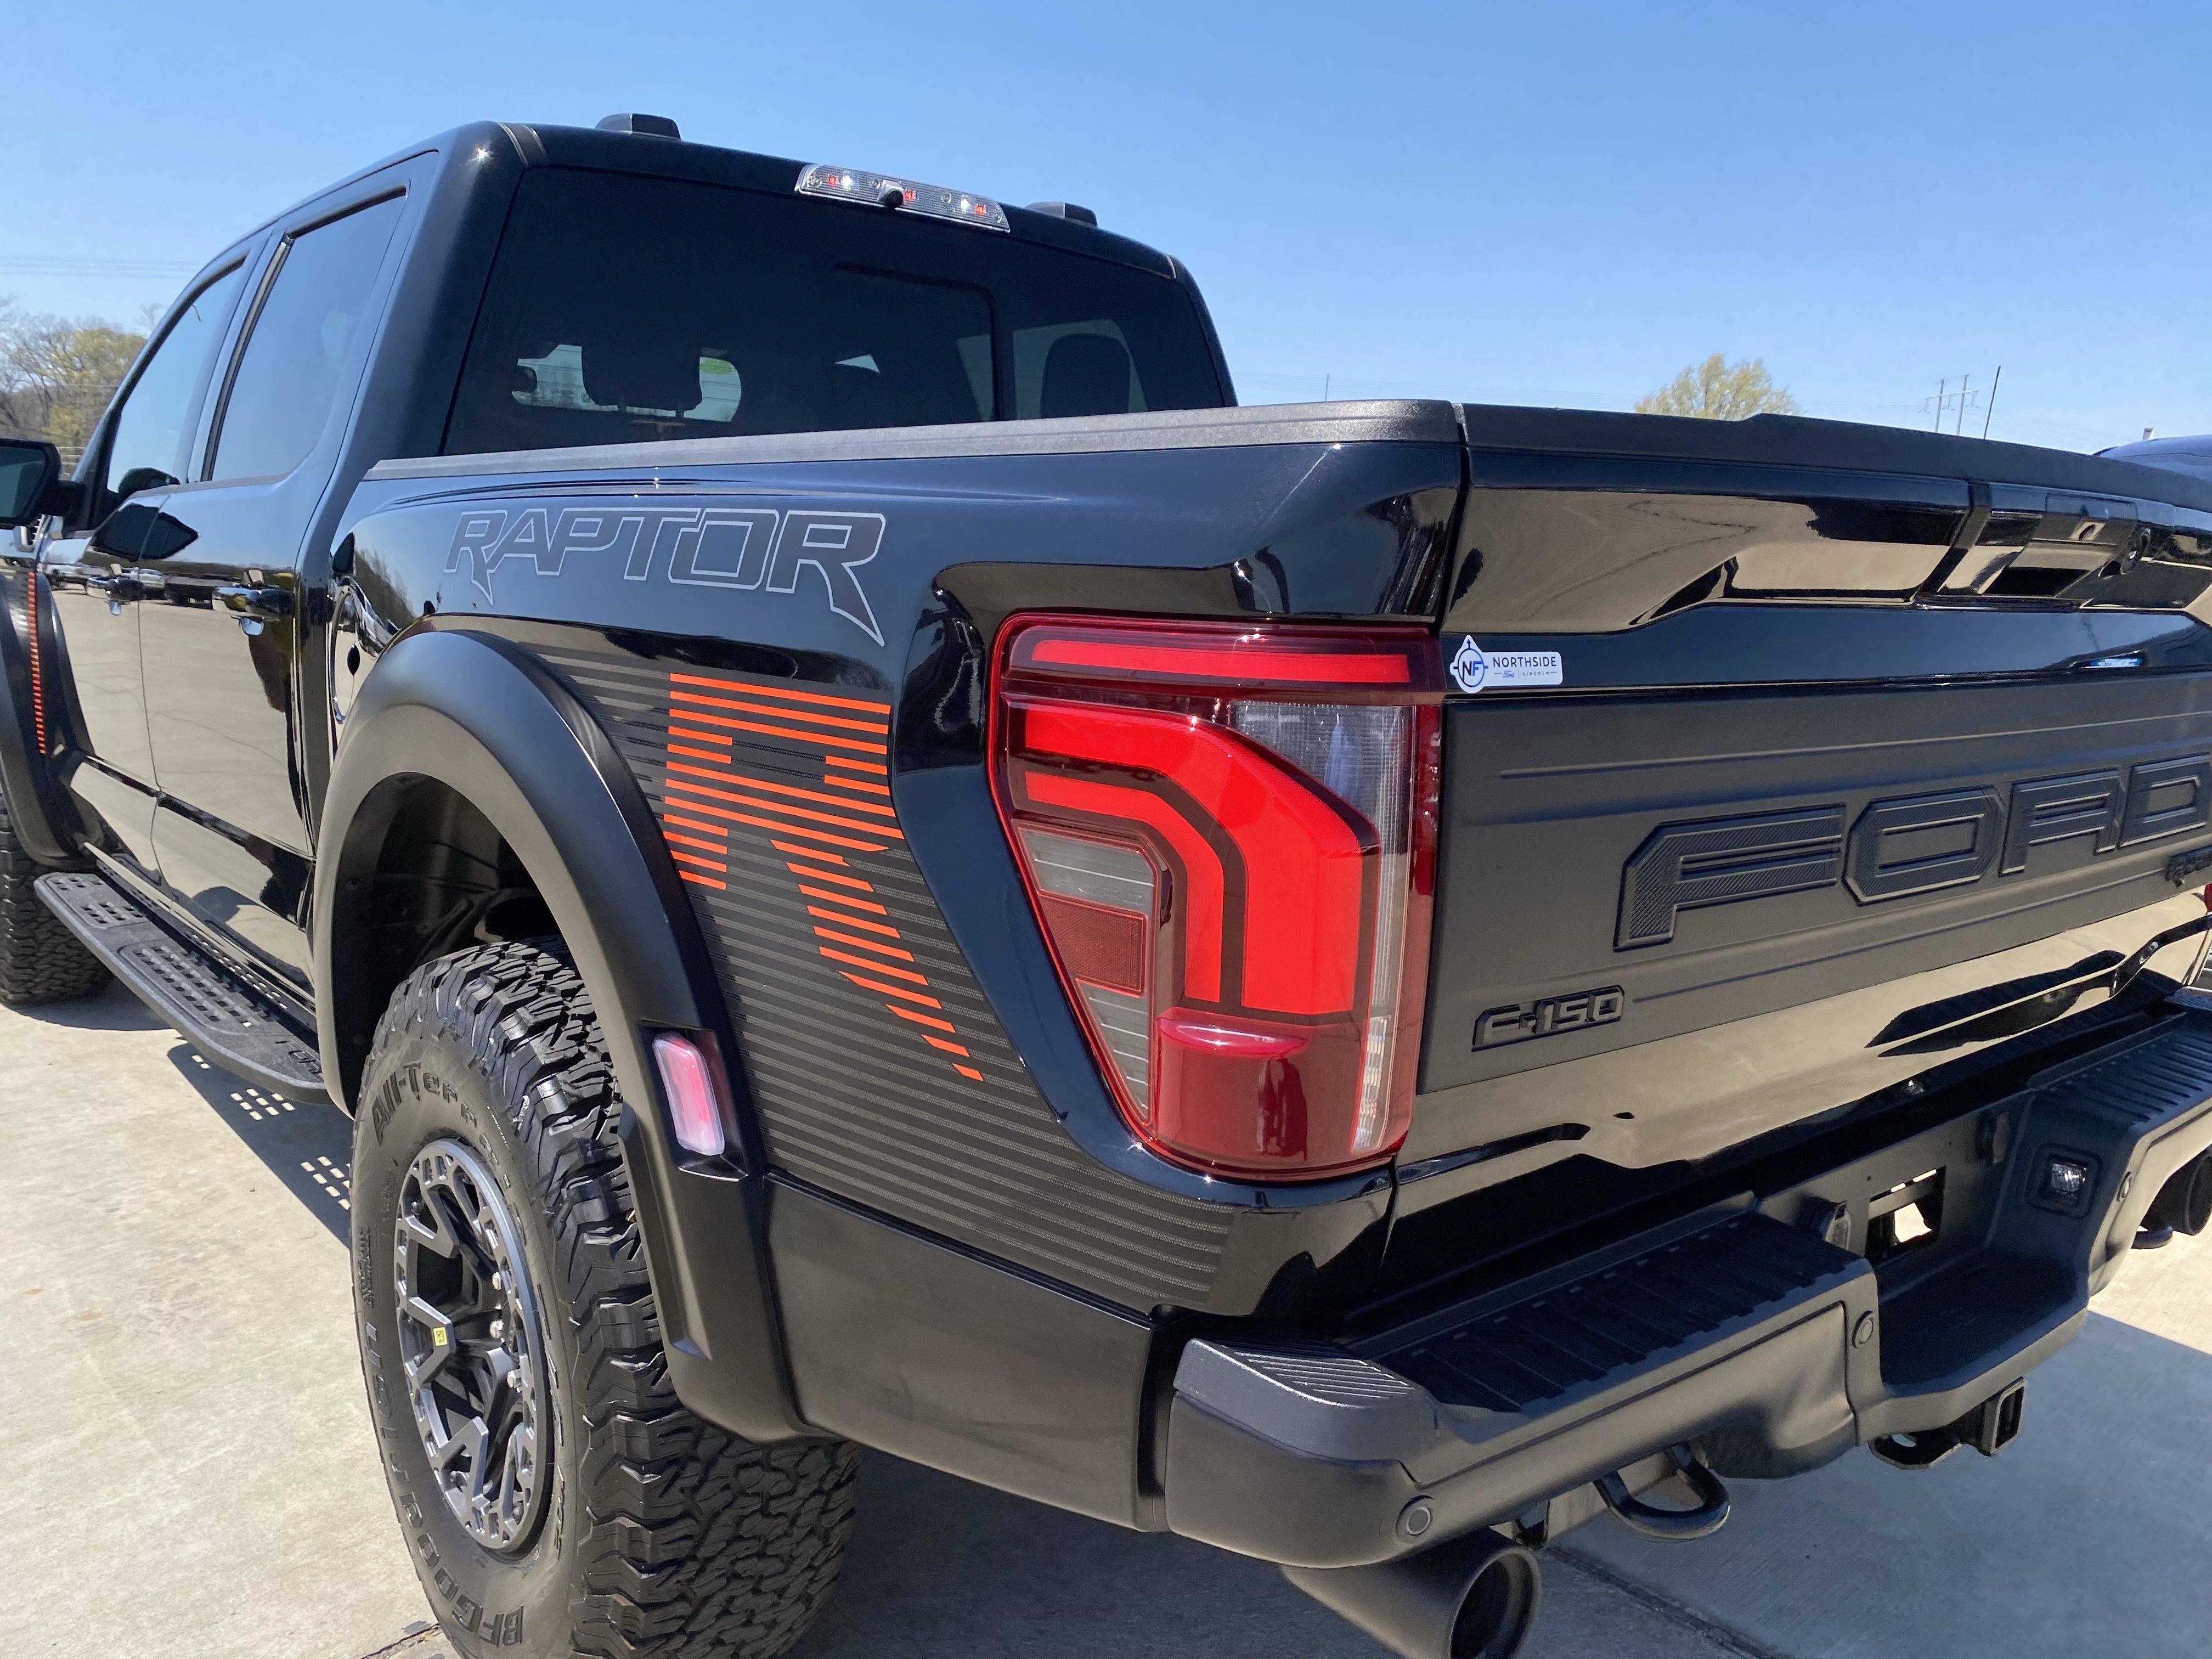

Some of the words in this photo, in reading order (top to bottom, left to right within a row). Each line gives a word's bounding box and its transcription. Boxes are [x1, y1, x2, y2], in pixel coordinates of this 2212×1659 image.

[444, 507, 886, 647] RAPTOR
[1493, 656, 1557, 668] NORTHSIDE
[1613, 752, 2212, 951] FORD
[1471, 984, 1625, 1052] F-150
